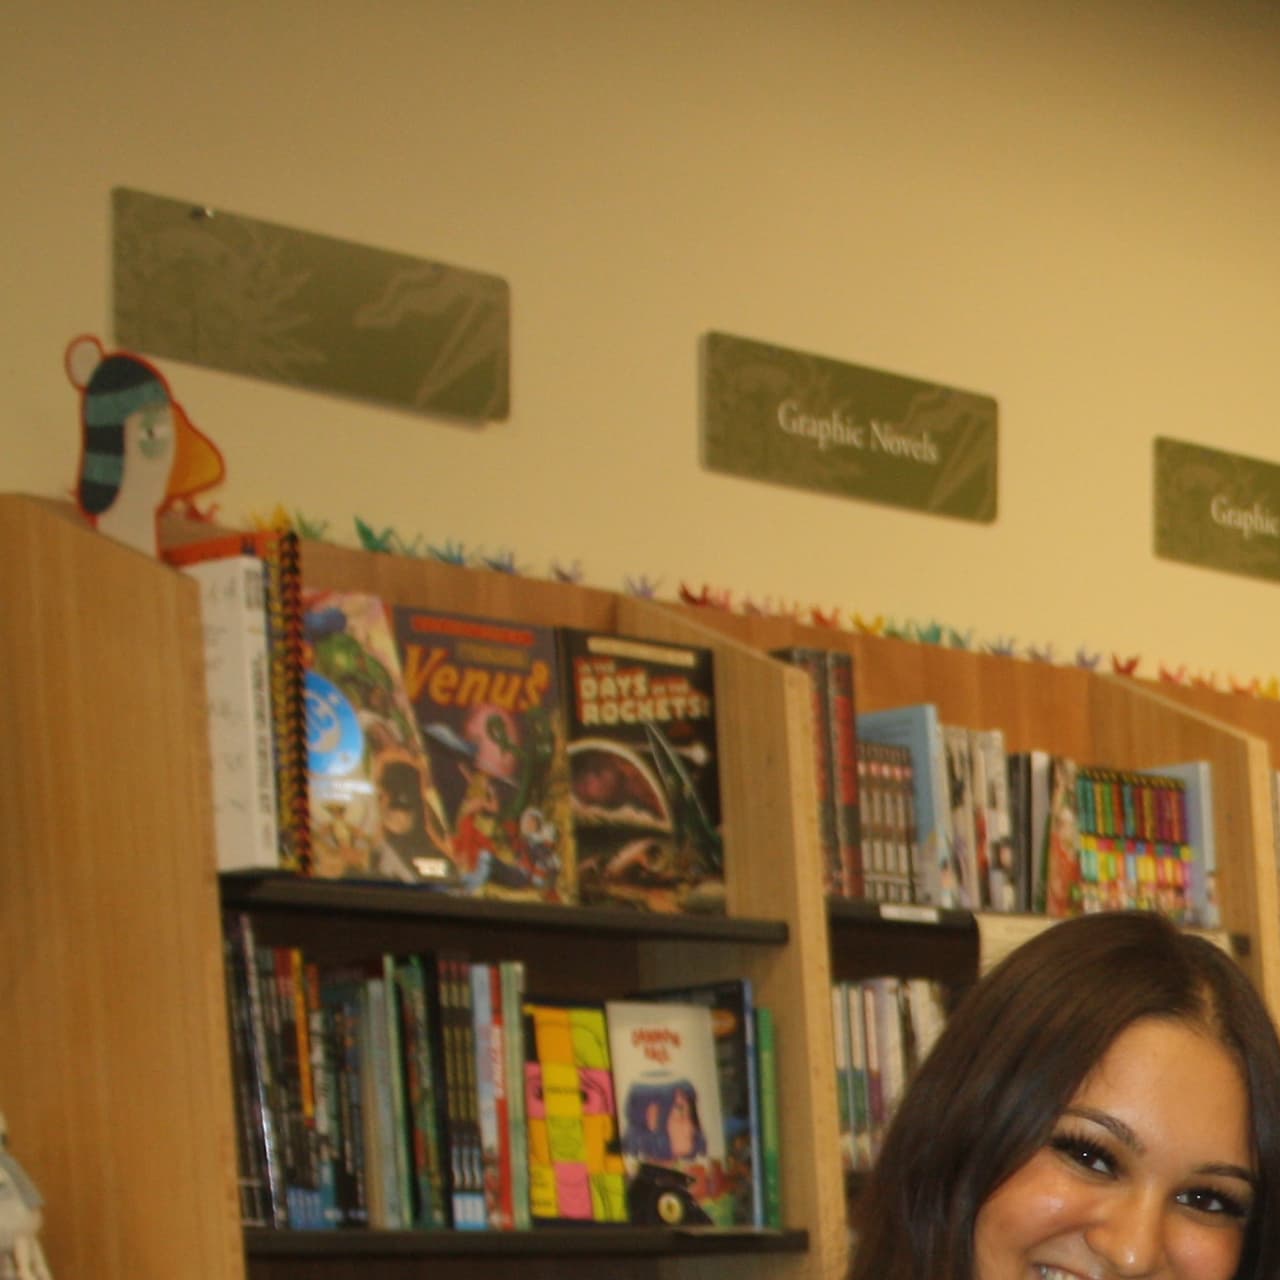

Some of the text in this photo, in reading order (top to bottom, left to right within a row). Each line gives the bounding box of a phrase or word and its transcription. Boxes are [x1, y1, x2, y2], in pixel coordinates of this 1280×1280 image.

[777, 402, 938, 466] Graphic Novels
[1211, 496, 1279, 539] Graphic
[403, 642, 549, 712] Venus
[579, 672, 647, 702] DAYS
